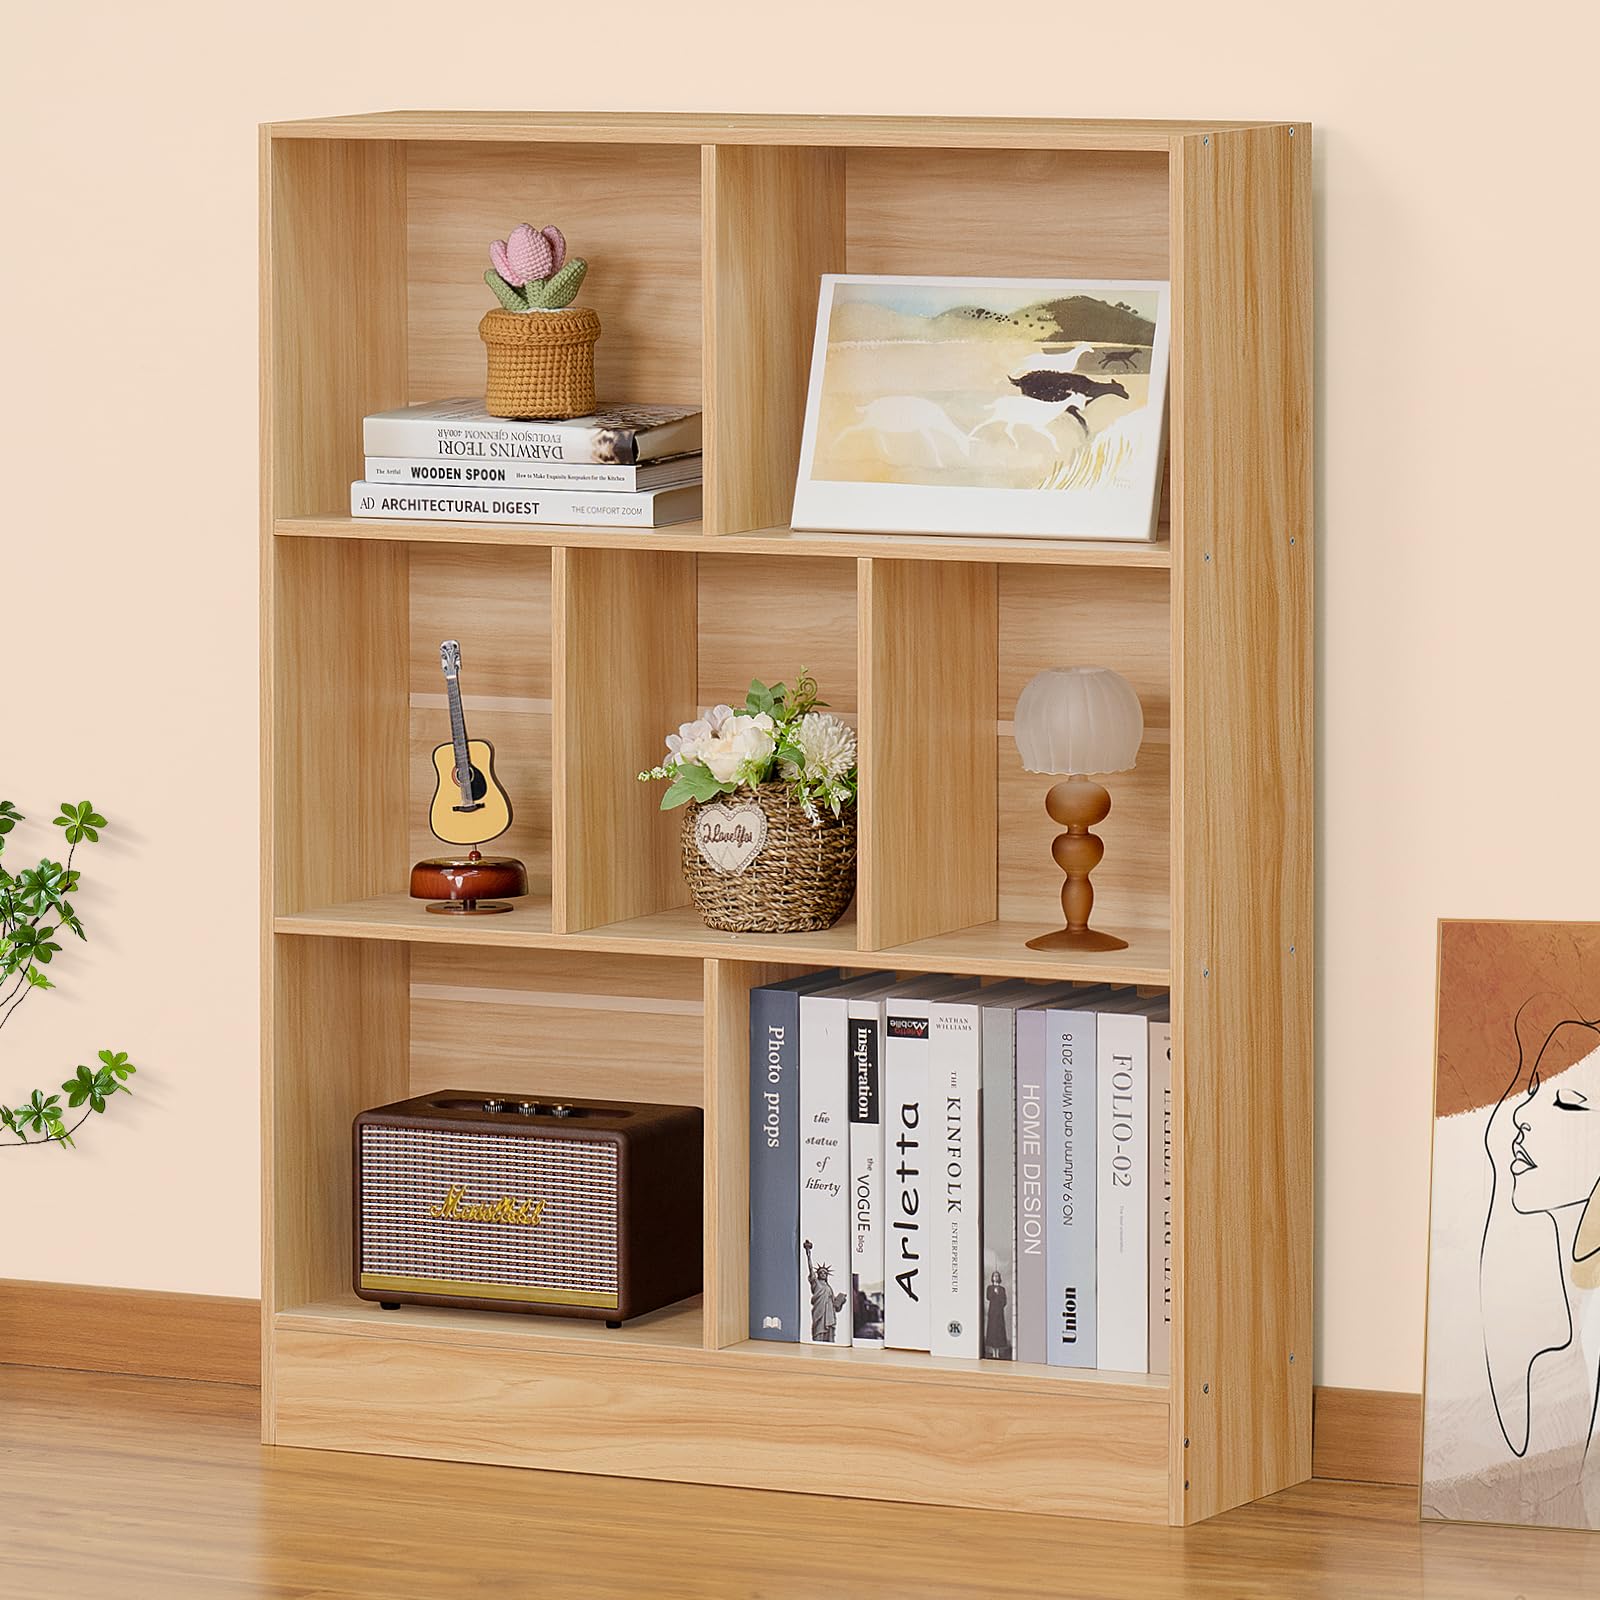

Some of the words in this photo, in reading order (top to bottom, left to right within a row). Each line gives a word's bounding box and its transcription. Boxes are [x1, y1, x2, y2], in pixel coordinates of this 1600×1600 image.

[438, 440, 486, 456] TEORI
[465, 429, 509, 440] GJENNOM
[511, 430, 562, 443] EVOLUSJON
[490, 442, 564, 460] DARWINS
[411, 467, 461, 480] WOODEN
[465, 469, 506, 481] SPOON
[360, 497, 375, 510] AD
[381, 498, 489, 514] ARCHITECTURAL
[492, 501, 540, 515] DIGEST
[571, 506, 586, 515] THE
[587, 506, 620, 516] COMFORT
[621, 507, 643, 516] ZOOM
[936, 1023, 972, 1031] WILLIAMS
[768, 1025, 785, 1084] Photo
[1062, 1033, 1073, 1065] 2018
[854, 1027, 873, 1118] inspiration
[1062, 1068, 1073, 1109] Winter
[764, 1091, 780, 1148] props
[813, 1112, 830, 1124] the
[1022, 1083, 1041, 1155] HOME
[1063, 1111, 1073, 1138] and
[1112, 1054, 1133, 1187] FOLIO-02
[805, 1136, 838, 1147] statue
[947, 1096, 962, 1213] KINFOLK
[816, 1157, 830, 1173] of
[1063, 1141, 1074, 1191] Autumn
[805, 1177, 841, 1196] liberty
[893, 1102, 919, 1302] Arletta
[857, 1175, 870, 1231] VOGUE
[1063, 1193, 1074, 1226] NO.9
[856, 1235, 865, 1253] blog
[951, 1222, 959, 1293] ENTERPRENEUR
[1062, 1287, 1077, 1343] Union
